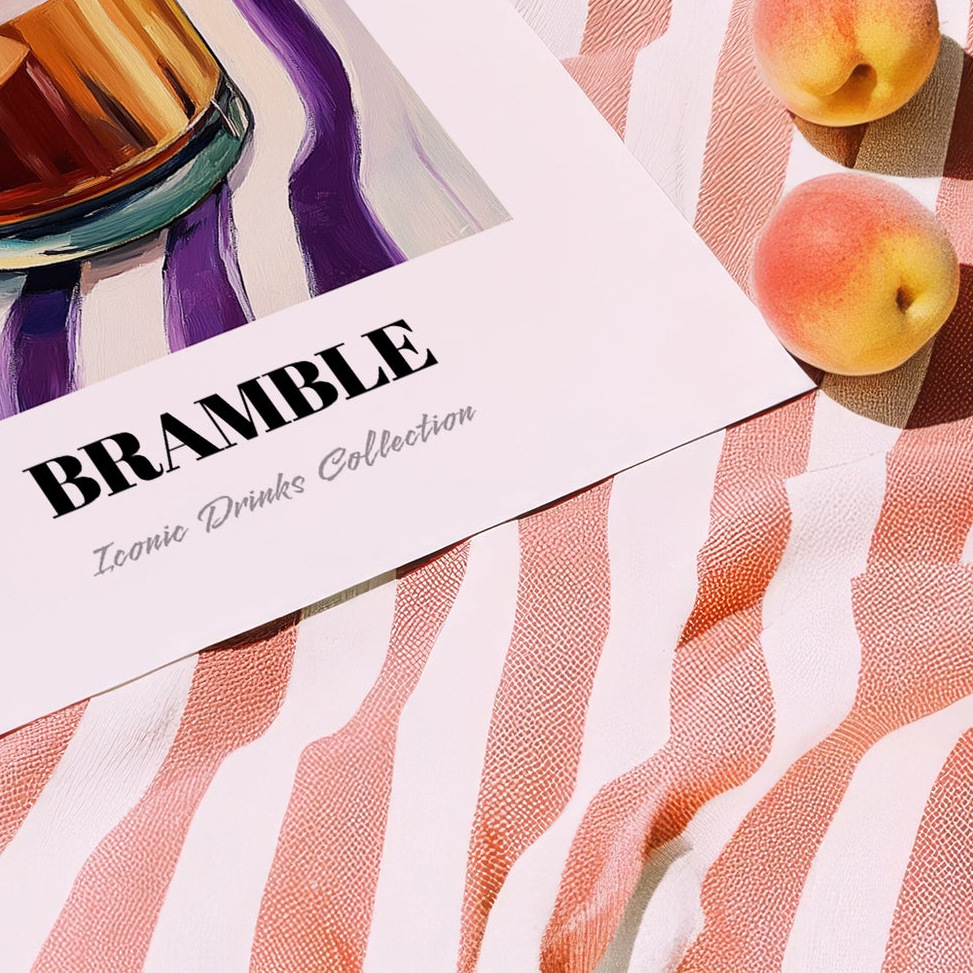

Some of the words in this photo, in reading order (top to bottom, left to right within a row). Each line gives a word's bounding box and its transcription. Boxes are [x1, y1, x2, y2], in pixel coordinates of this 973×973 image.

[23, 319, 439, 519] BRAMBLE
[93, 525, 188, 576] Iconic
[197, 473, 306, 533] Drinks
[319, 406, 476, 481] Collection
